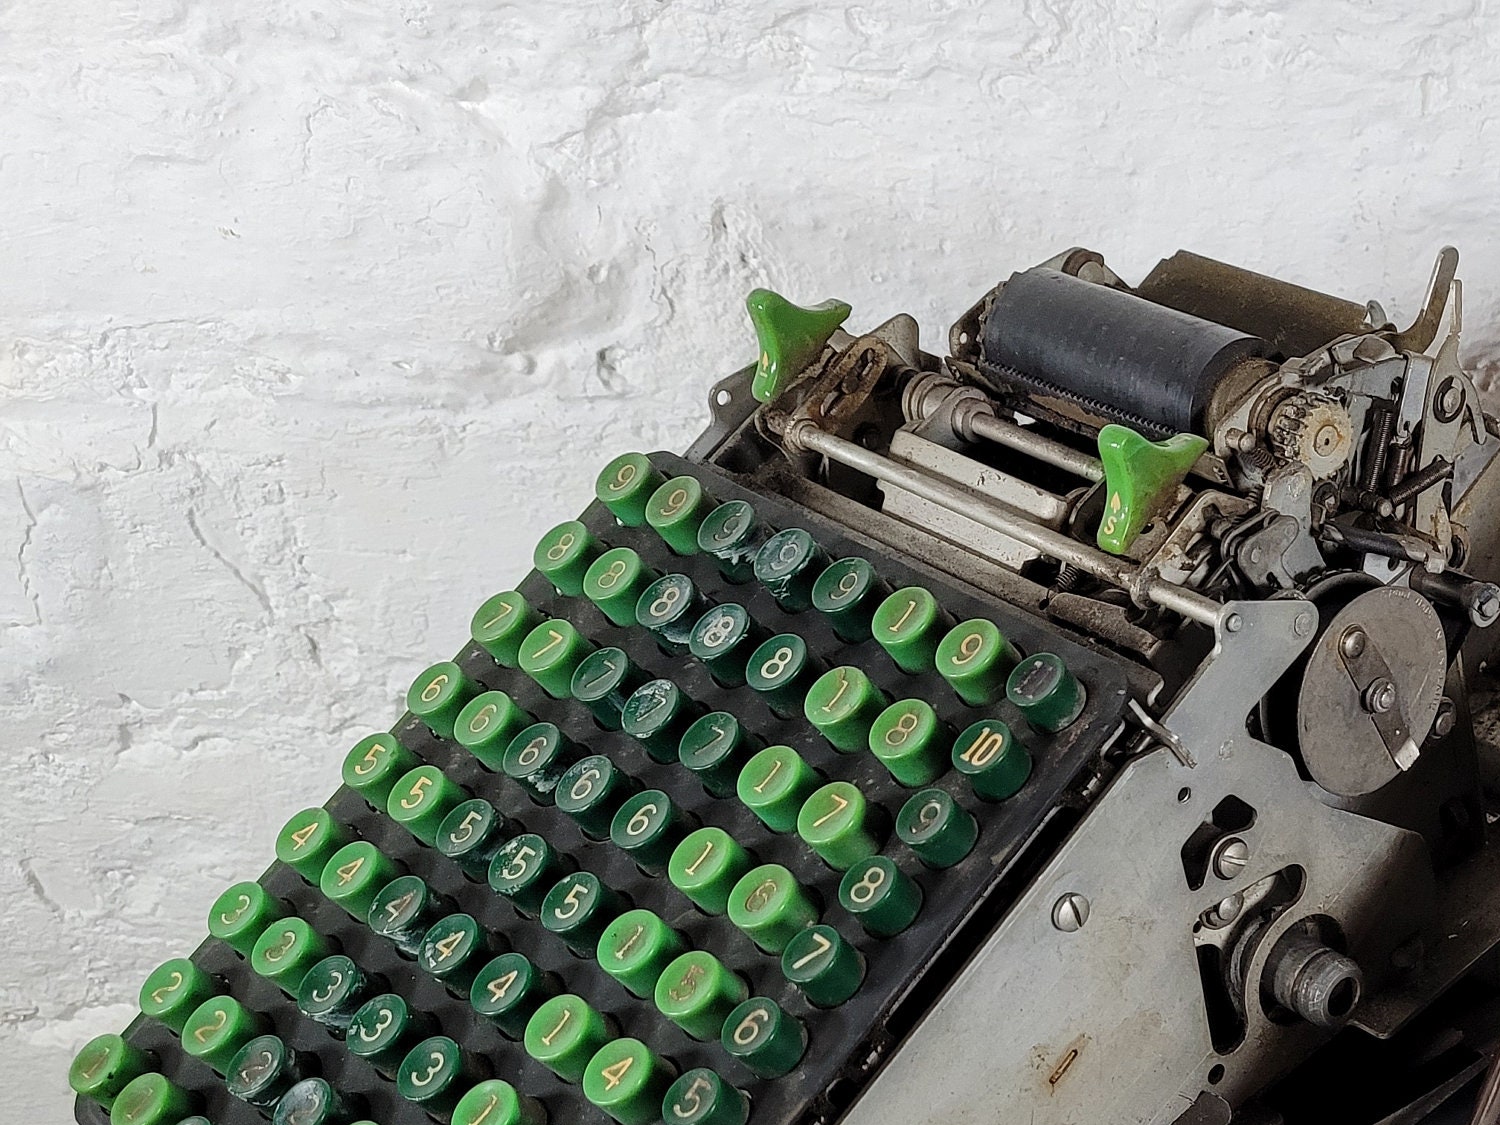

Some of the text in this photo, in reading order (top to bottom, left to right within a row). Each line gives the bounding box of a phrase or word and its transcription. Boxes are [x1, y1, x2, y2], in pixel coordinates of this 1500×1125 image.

[609, 464, 636, 491] 9
[660, 489, 687, 516] 9
[714, 512, 741, 541] 9
[1104, 516, 1117, 535] S
[548, 533, 575, 560] 8
[770, 543, 800, 571] 9
[598, 560, 626, 588] 8
[829, 572, 858, 600] 9
[483, 601, 513, 629] 7
[650, 587, 680, 617] 8
[889, 600, 916, 631] 1
[532, 629, 563, 659] 7
[703, 615, 735, 647] 8
[761, 647, 793, 679] 8
[951, 633, 983, 665] 9
[421, 674, 449, 702] 6
[585, 659, 615, 688] 7
[636, 693, 667, 722] 7
[822, 680, 848, 712] 1
[469, 704, 497, 733] 6
[886, 713, 918, 746] 8
[519, 736, 547, 766] 6
[694, 724, 725, 755] 7
[960, 727, 1003, 765] 10
[354, 744, 386, 775] 5
[401, 776, 433, 809] 5
[570, 769, 600, 800] 6
[754, 760, 782, 793] 1
[450, 811, 483, 843] 5
[626, 804, 657, 836] 6
[813, 794, 848, 828] 7
[912, 801, 942, 834] 9
[291, 822, 319, 851] 4
[337, 857, 365, 886] 4
[503, 845, 536, 880] 5
[684, 841, 713, 875] 1
[745, 880, 777, 912] 6
[851, 866, 885, 903] 8
[221, 894, 250, 925] 3
[385, 890, 415, 923] 4
[555, 884, 588, 920] 5
[265, 931, 296, 962] 3
[435, 931, 465, 962] 4
[615, 925, 644, 960] 1
[792, 932, 831, 970] 7
[152, 972, 183, 1004] 2
[312, 972, 342, 1003] 3
[487, 970, 518, 1003] 4
[669, 965, 704, 1001] 5
[195, 1011, 227, 1043] 2
[360, 1009, 393, 1042] 3
[542, 1010, 571, 1046] 1
[733, 1008, 769, 1045] 6
[82, 1047, 110, 1079] 1
[241, 1052, 272, 1084] 2
[411, 1052, 444, 1086] 3
[602, 1057, 634, 1091] 4
[673, 1077, 711, 1117] 5
